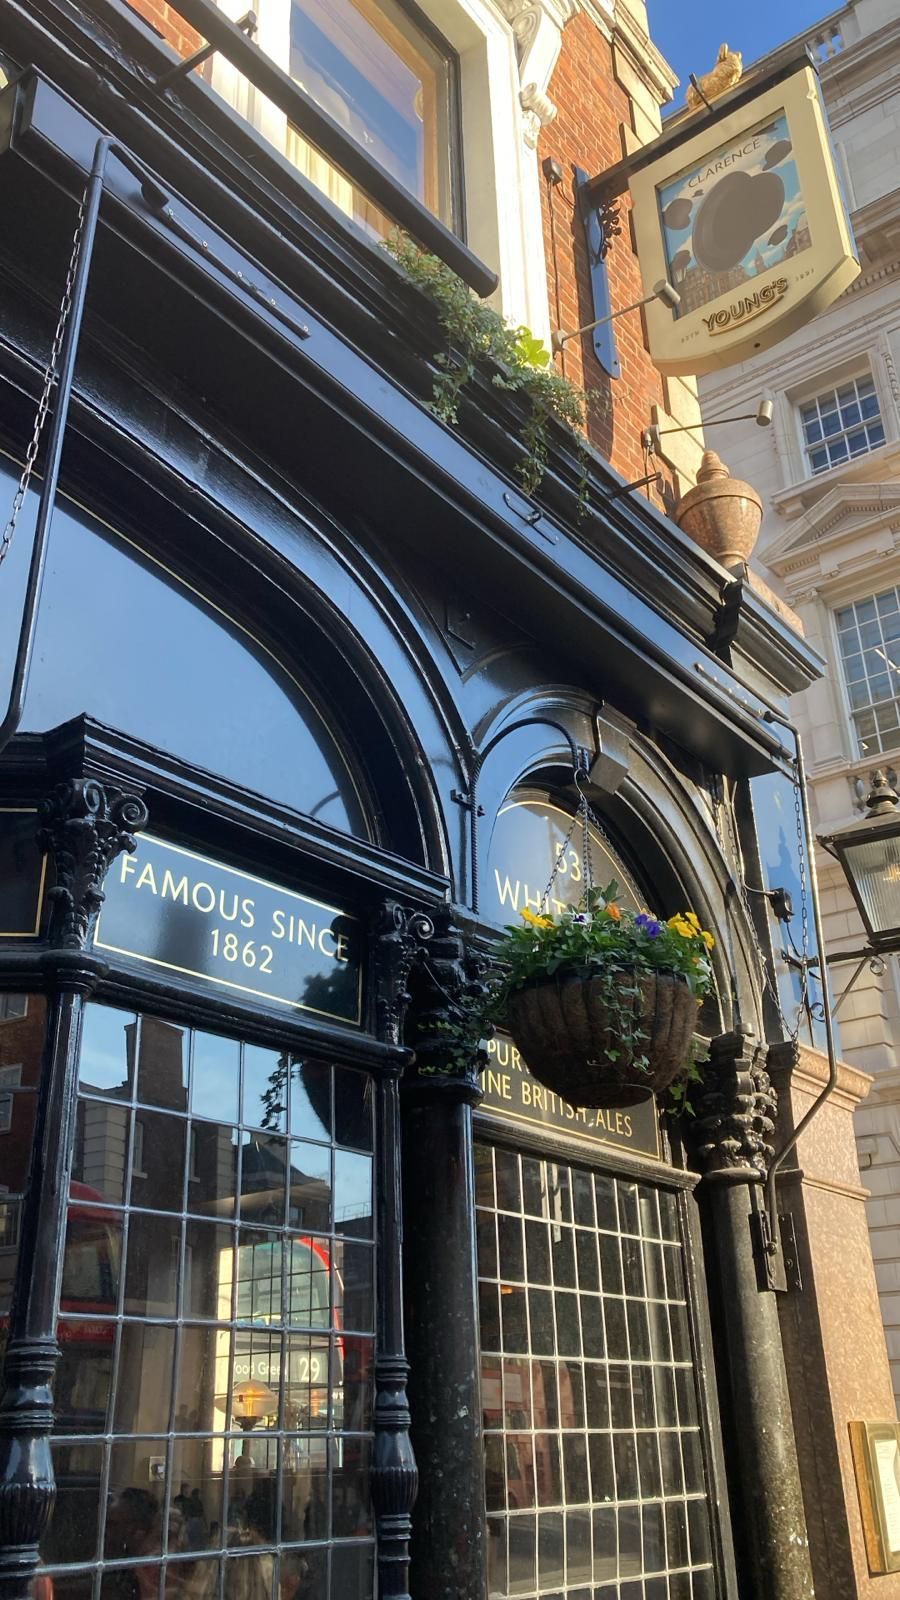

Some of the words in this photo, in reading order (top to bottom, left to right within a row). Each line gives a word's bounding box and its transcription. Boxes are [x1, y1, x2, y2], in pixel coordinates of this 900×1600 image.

[687, 138, 761, 189] CLARENCE
[702, 277, 788, 332] YOUNG'S
[555, 842, 581, 881] 53
[120, 854, 255, 928] FAMOUS
[271, 910, 349, 962] SINCE
[211, 928, 273, 973] 1862
[477, 1069, 512, 1100] INE
[595, 1108, 633, 1138] ALES
[299, 1357, 321, 1381] 29
